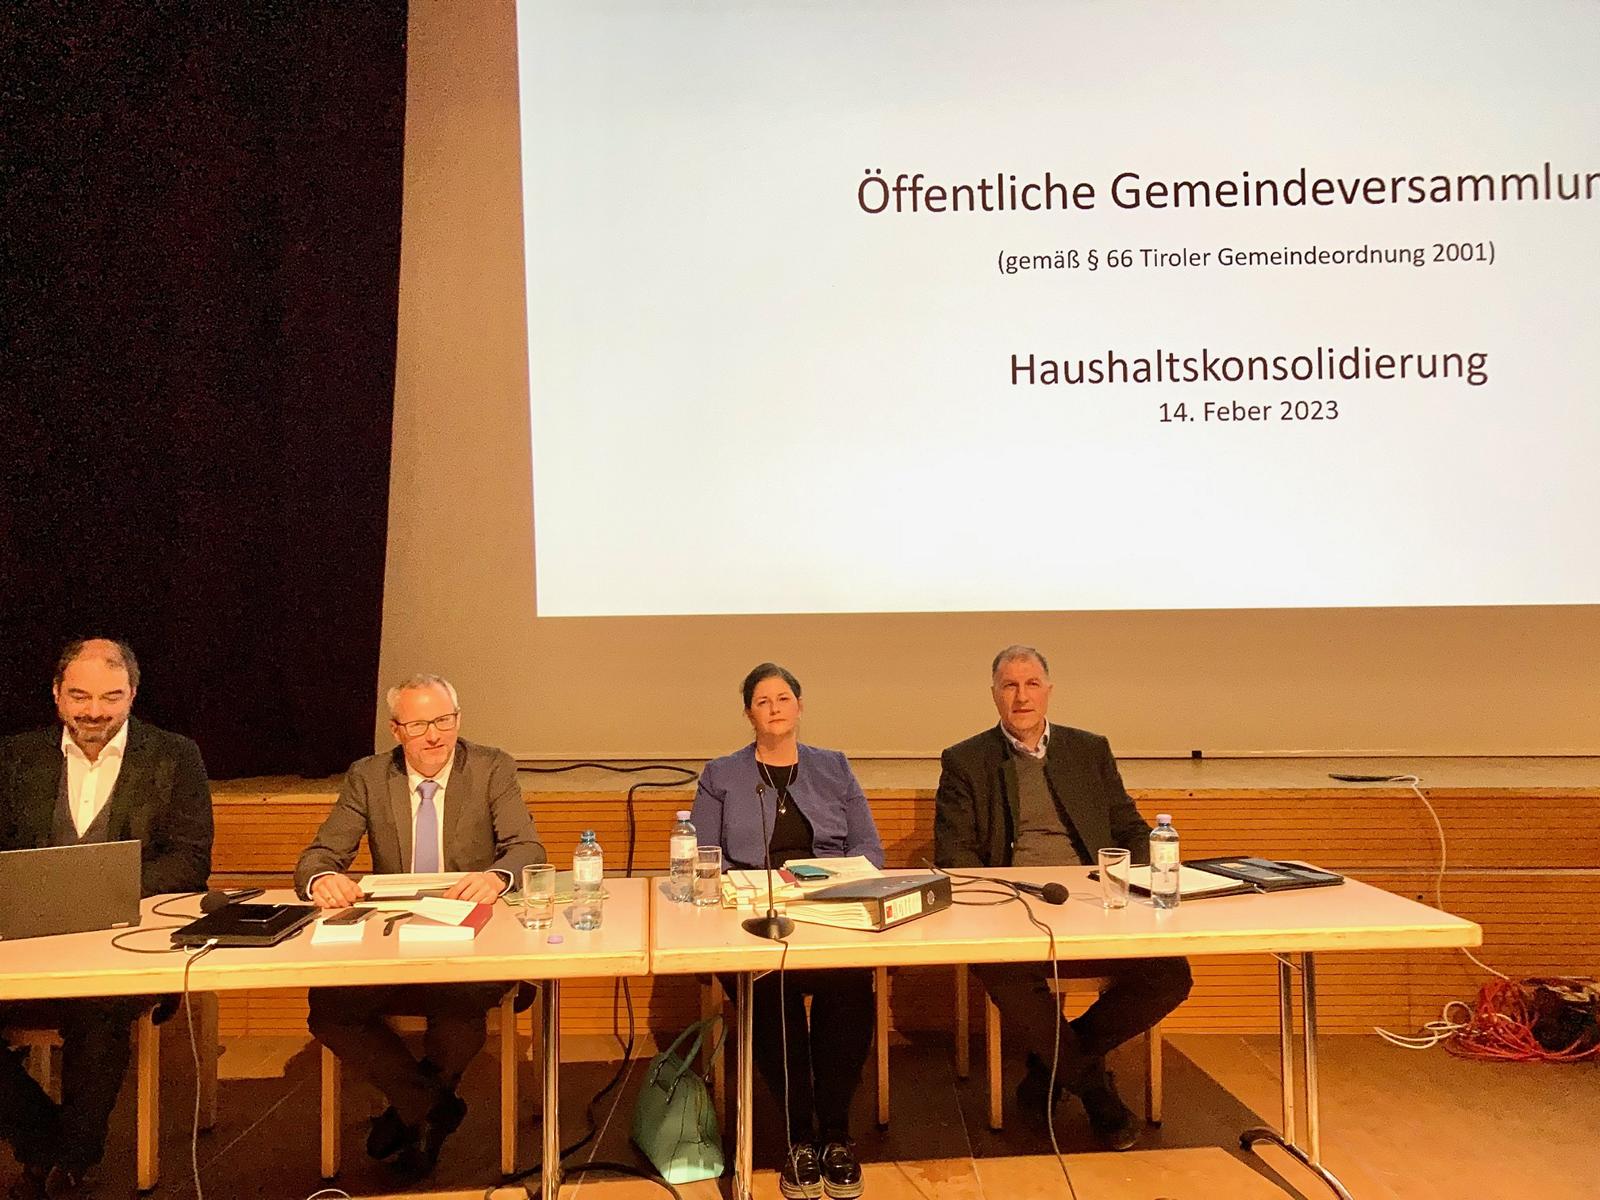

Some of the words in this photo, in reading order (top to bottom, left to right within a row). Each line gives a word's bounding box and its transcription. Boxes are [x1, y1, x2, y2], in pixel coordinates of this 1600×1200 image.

[857, 168, 1095, 214] Öffentliche
[998, 249, 1080, 275] (gemäß
[1087, 249, 1099, 272] §
[1106, 249, 1133, 268] 66
[1139, 247, 1212, 268] Tiroler
[1217, 244, 1425, 267] Gemeindeordnung
[1432, 241, 1495, 266] 2001)
[1011, 345, 1488, 386] Haushaltskonsolidierung
[1159, 402, 1195, 423] 14.
[1204, 400, 1272, 422] Feber
[1280, 400, 1339, 421] 2023
